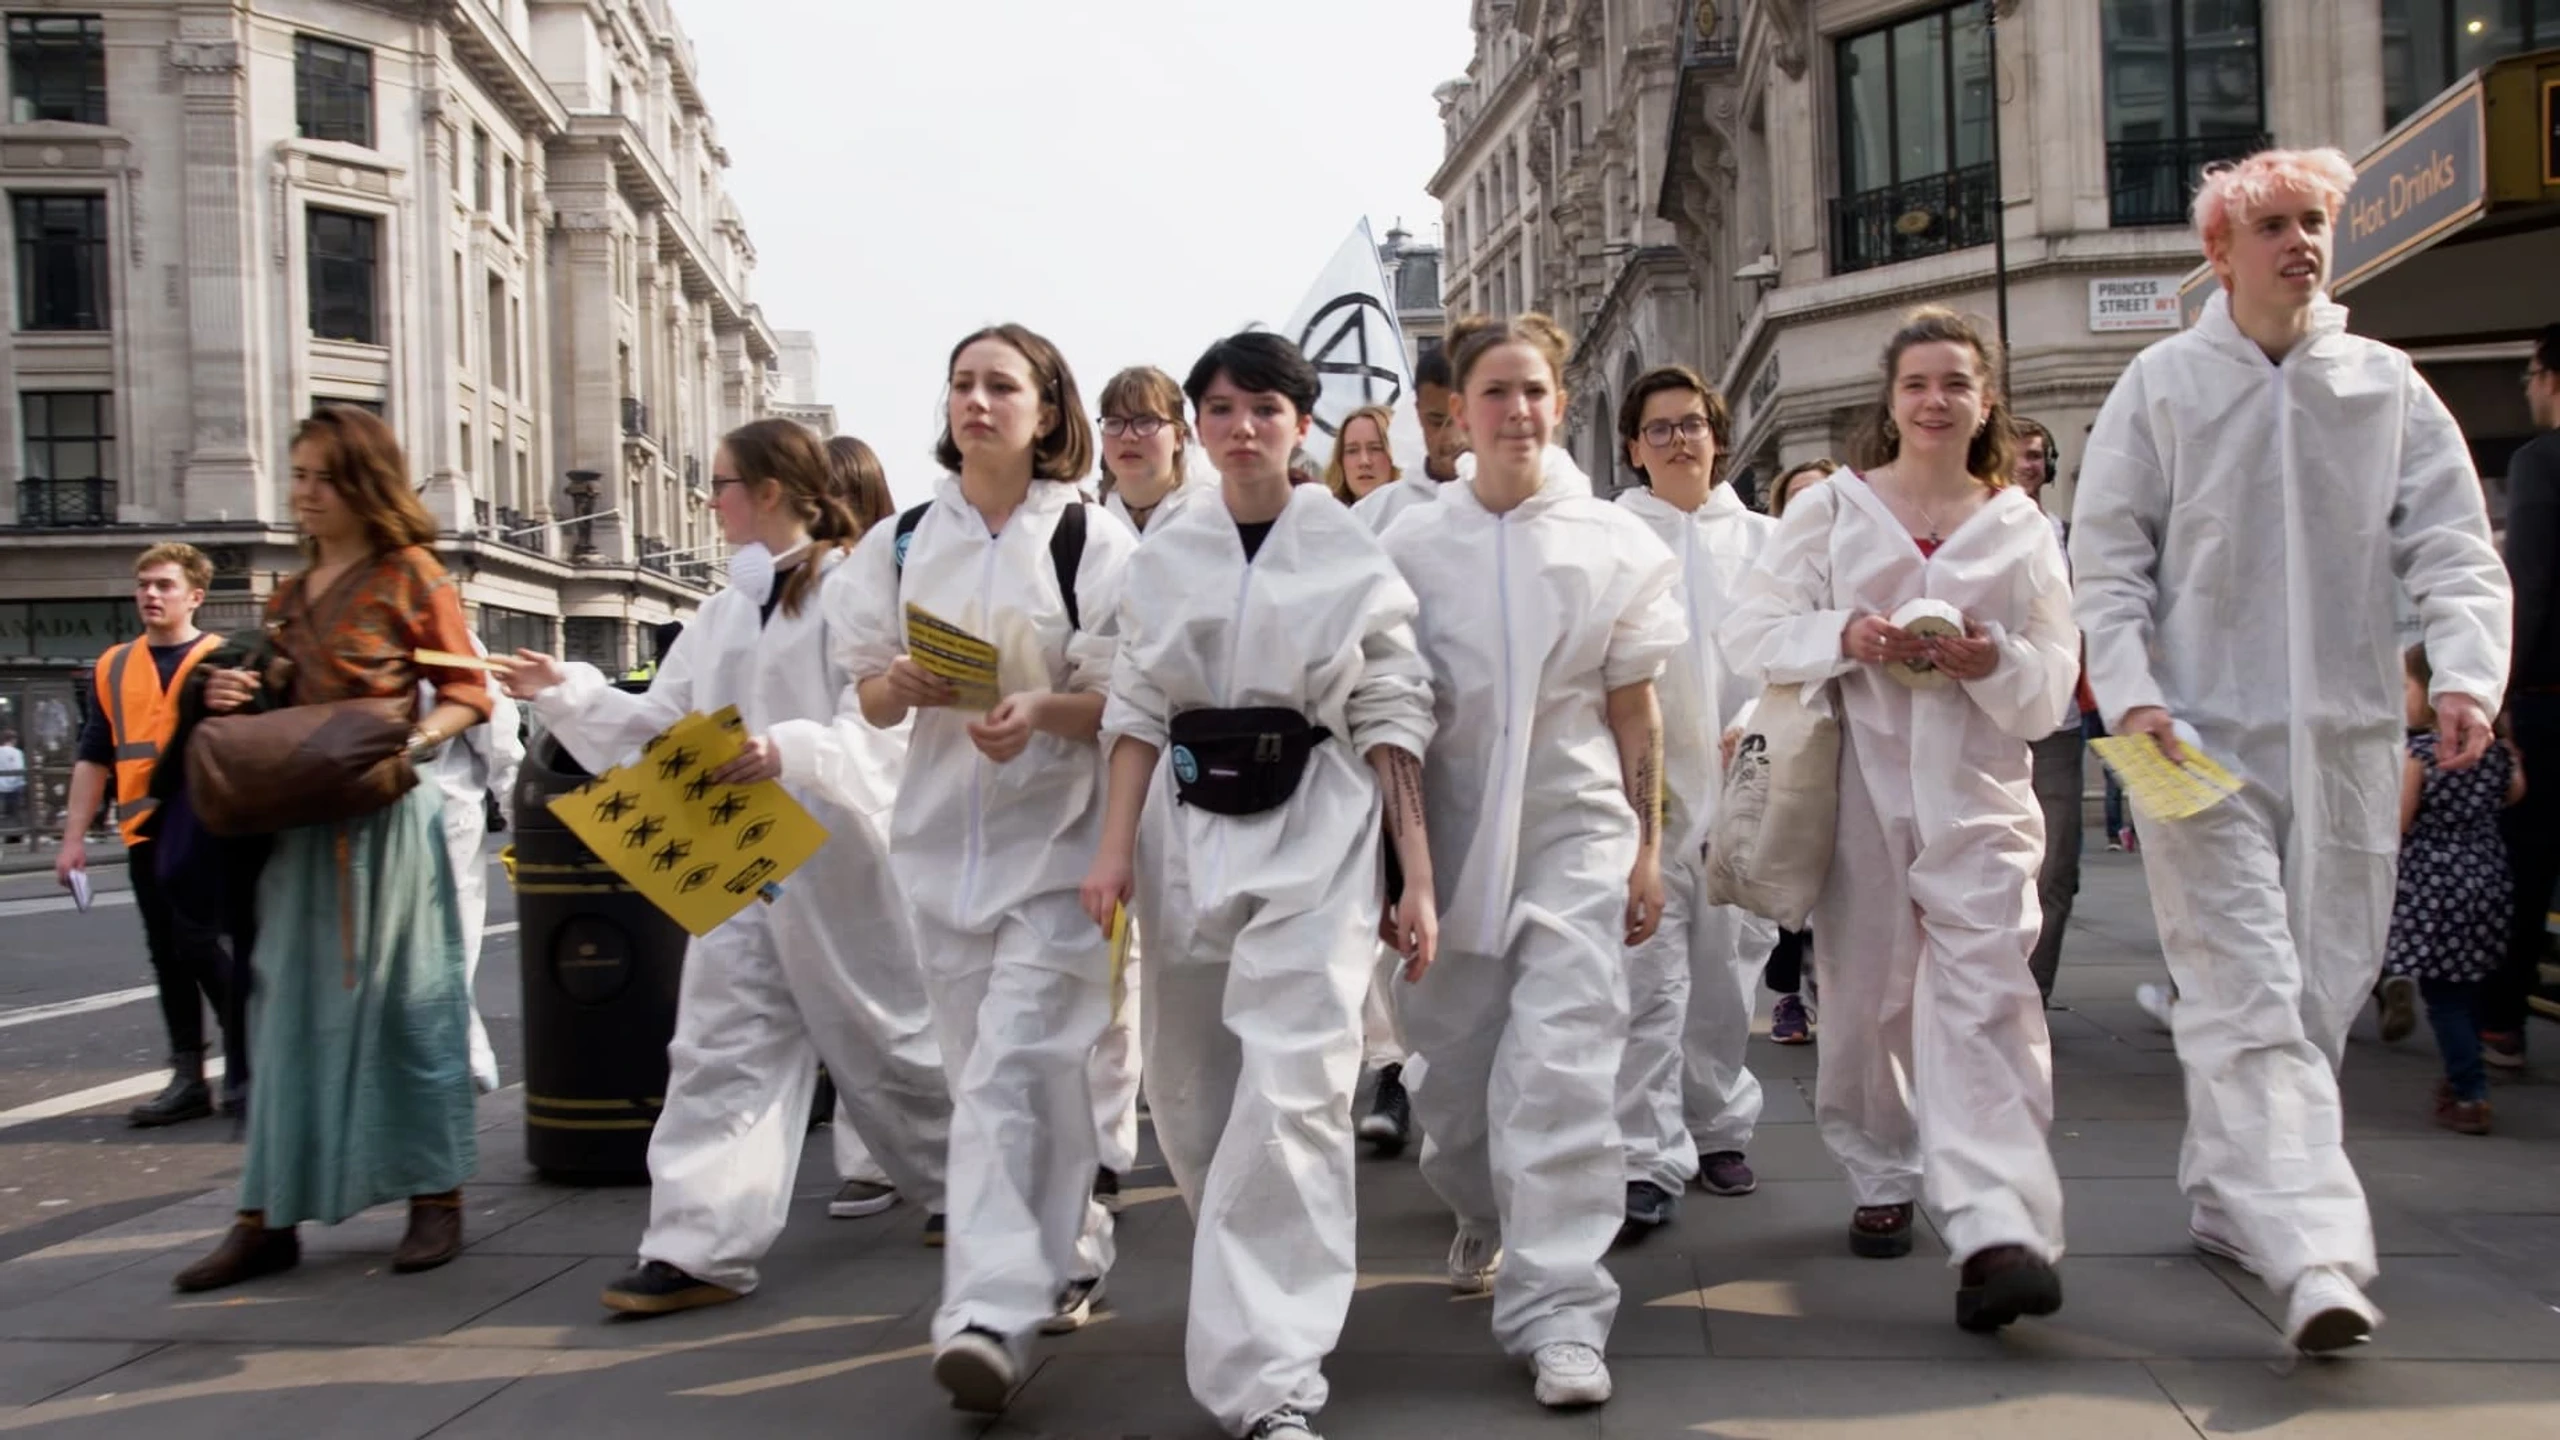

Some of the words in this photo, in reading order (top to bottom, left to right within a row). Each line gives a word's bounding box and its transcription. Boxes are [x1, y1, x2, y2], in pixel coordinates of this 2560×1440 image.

[2350, 196, 2387, 243] Hot
[2389, 149, 2455, 219] Drinks
[2098, 281, 2158, 296] PRINCES
[2098, 298, 2149, 313] STREET
[2155, 298, 2176, 311] W1
